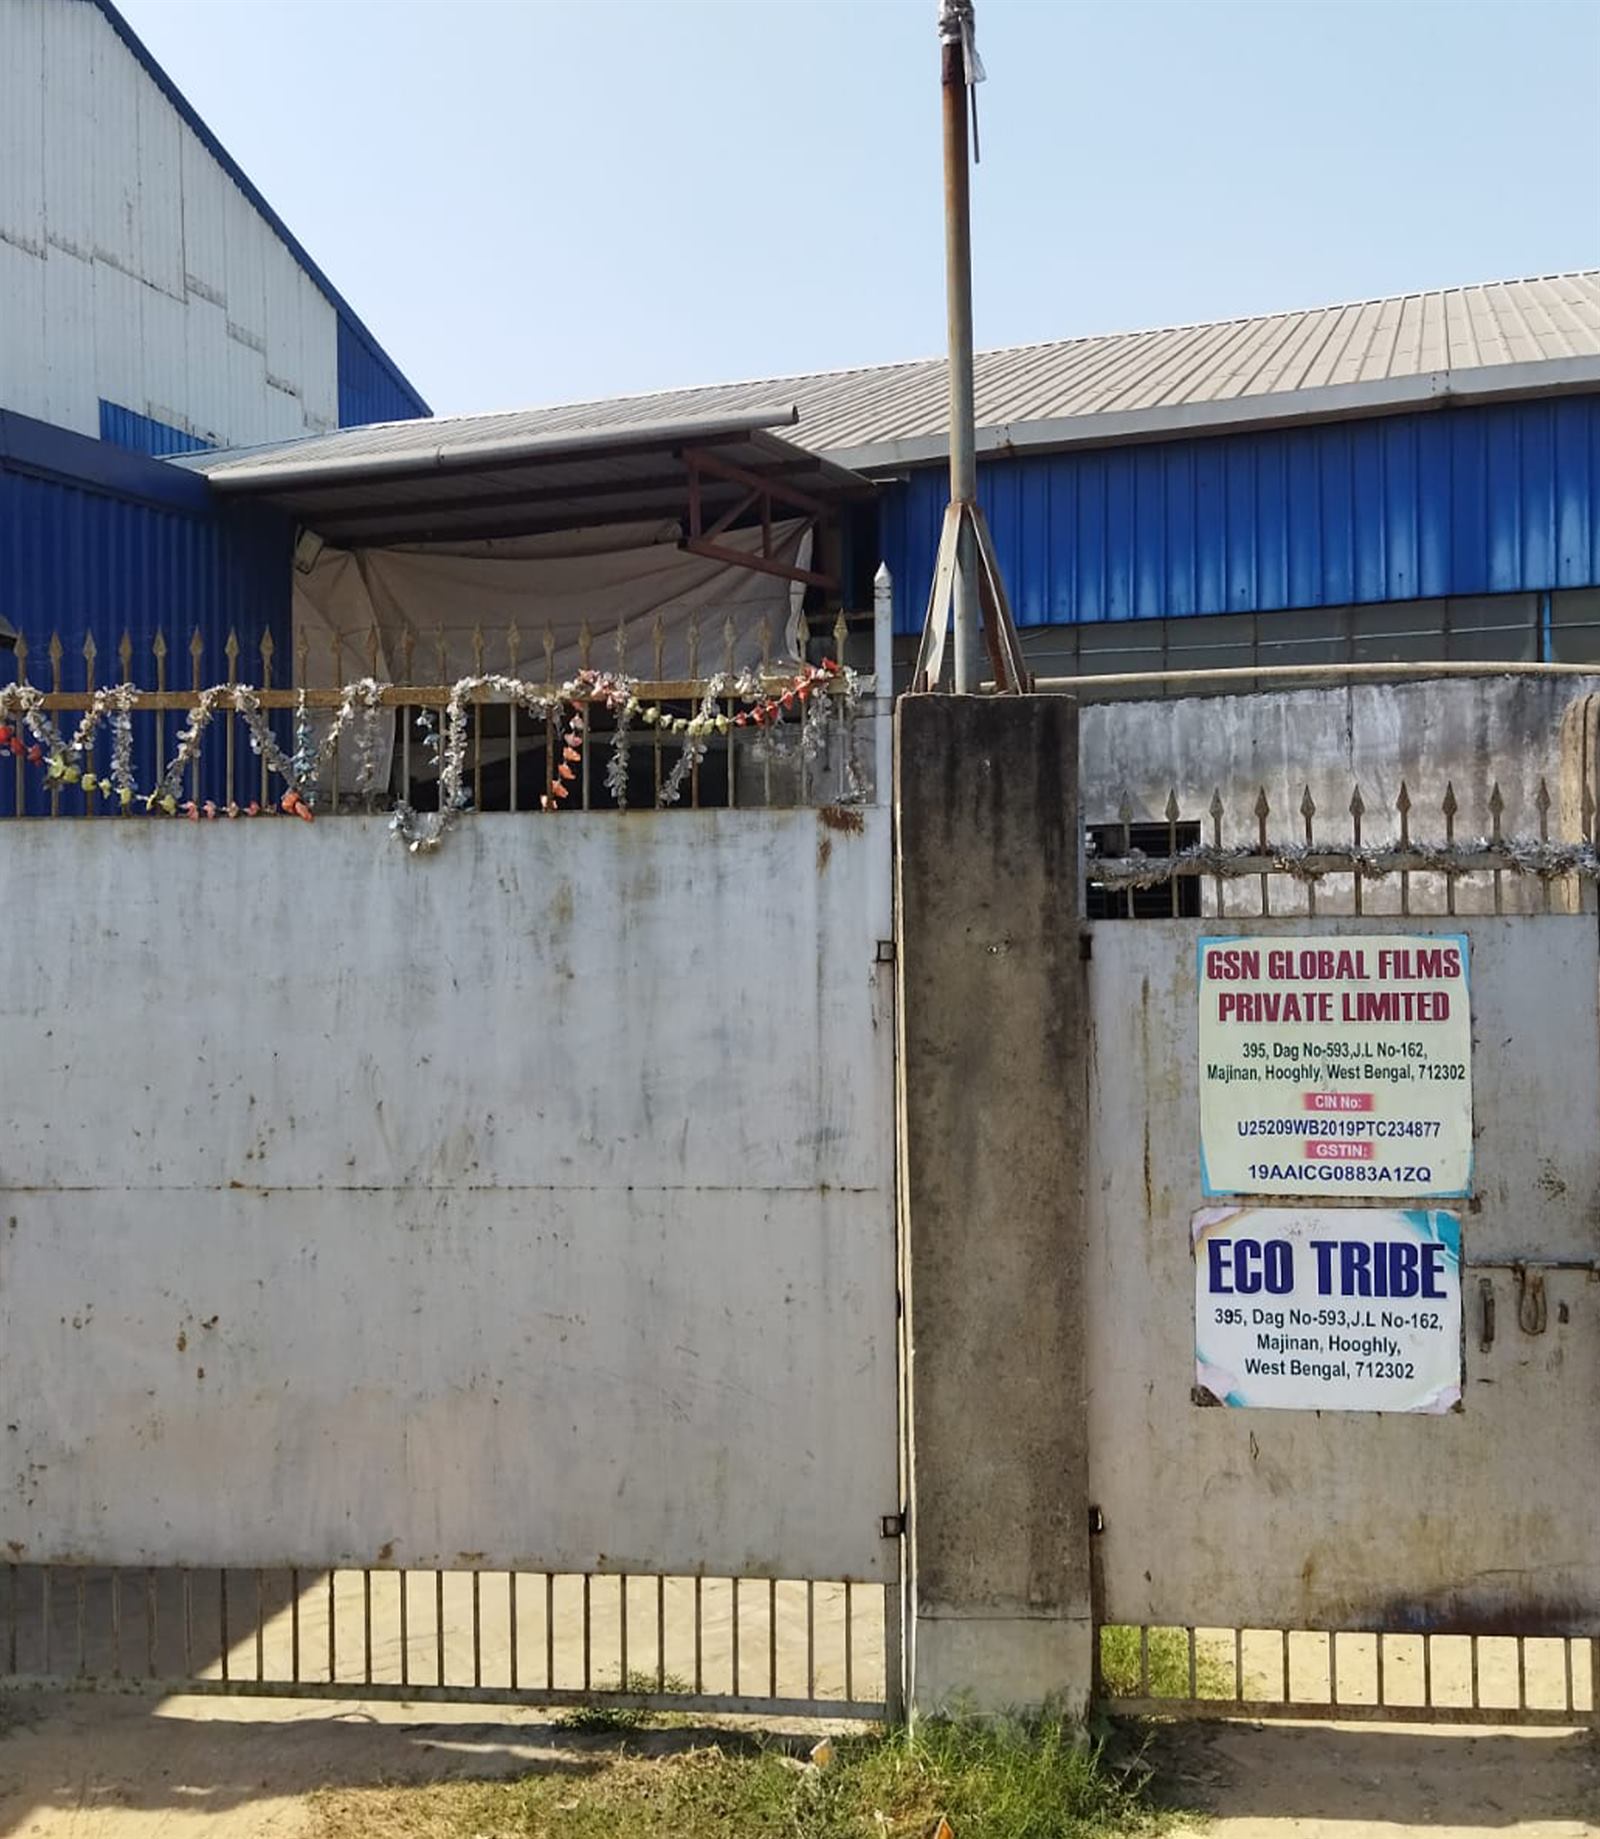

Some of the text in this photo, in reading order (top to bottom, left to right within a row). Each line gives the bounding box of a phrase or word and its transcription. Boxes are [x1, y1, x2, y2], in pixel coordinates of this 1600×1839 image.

[1207, 949, 1461, 980] GSN GLOBAL FILMS
[1218, 992, 1450, 1022] PRIVATE LIMITED
[1242, 1043, 1270, 1060] 395,
[1273, 1043, 1299, 1061] Dag
[1377, 1043, 1428, 1060] No-162,
[1207, 1064, 1465, 1084] Majinan, Hooghly, West Bengal, 712302
[1315, 1095, 1362, 1109] CIN No:
[1238, 1120, 1441, 1138] U25209WB2019PTC234877
[1316, 1144, 1368, 1158] GSTIN:
[1248, 1164, 1431, 1183] 19AAICG0883A1ZQ
[1207, 1239, 1447, 1299] ECO TRIBE
[1215, 1309, 1247, 1326] 395,
[1253, 1309, 1284, 1328] Dag
[1381, 1312, 1444, 1331] No-162,
[1257, 1334, 1401, 1357] Majinan, Hooghly,
[1245, 1358, 1414, 1381] West Bengal, 712302
